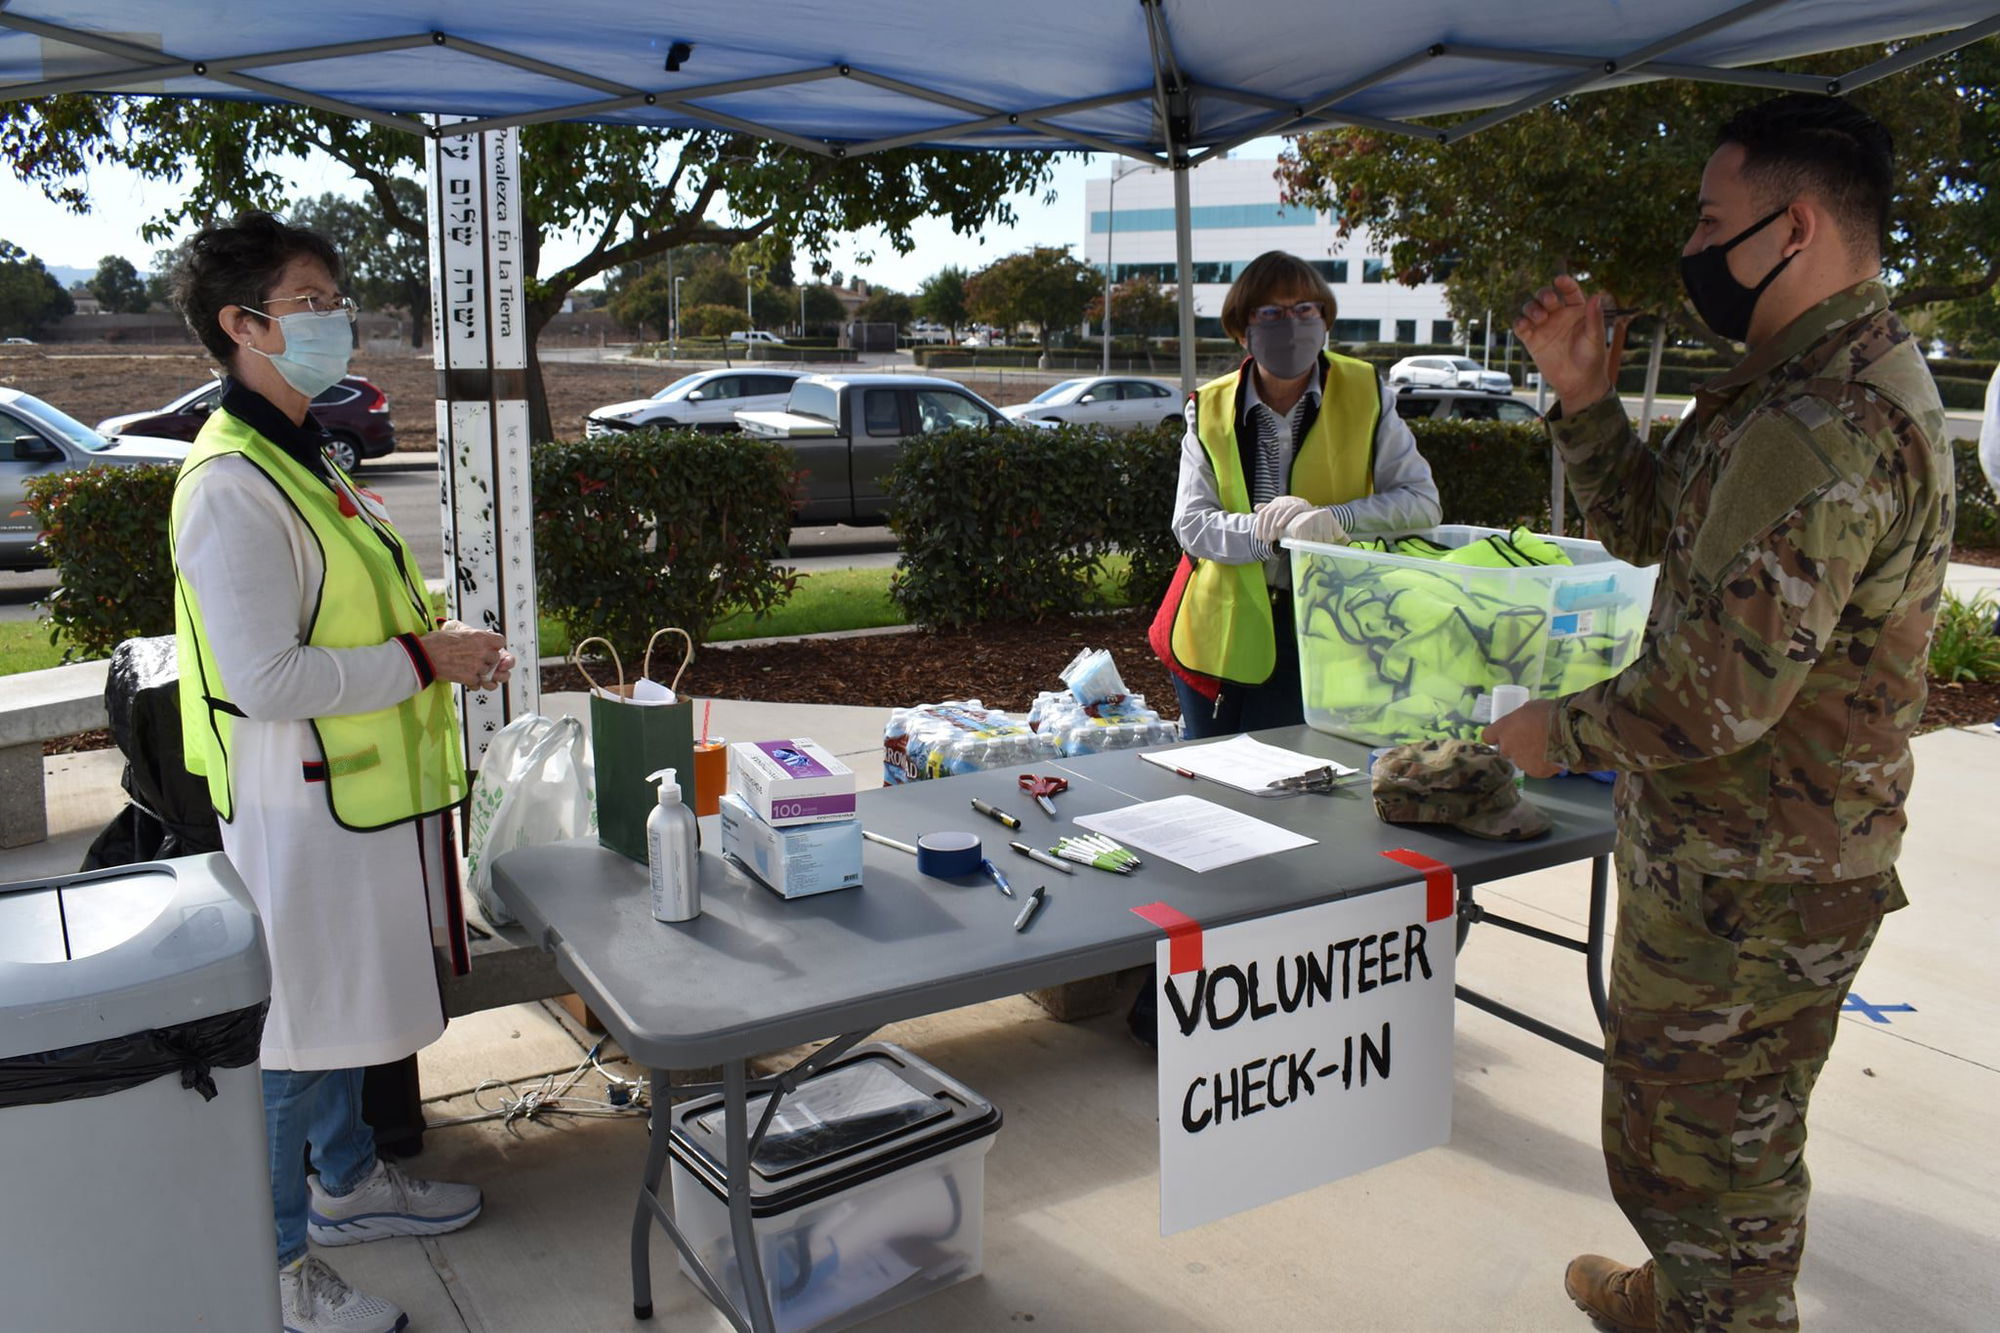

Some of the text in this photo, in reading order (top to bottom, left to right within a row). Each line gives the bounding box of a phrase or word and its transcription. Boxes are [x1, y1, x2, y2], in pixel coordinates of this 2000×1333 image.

[450, 178, 476, 247] שלום
[495, 127, 514, 337] Prevalezca En La Tierra
[772, 803, 802, 818] 100
[1164, 923, 1433, 1037] VOLUNTEER
[1182, 1022, 1390, 1134] CHECK-IN
